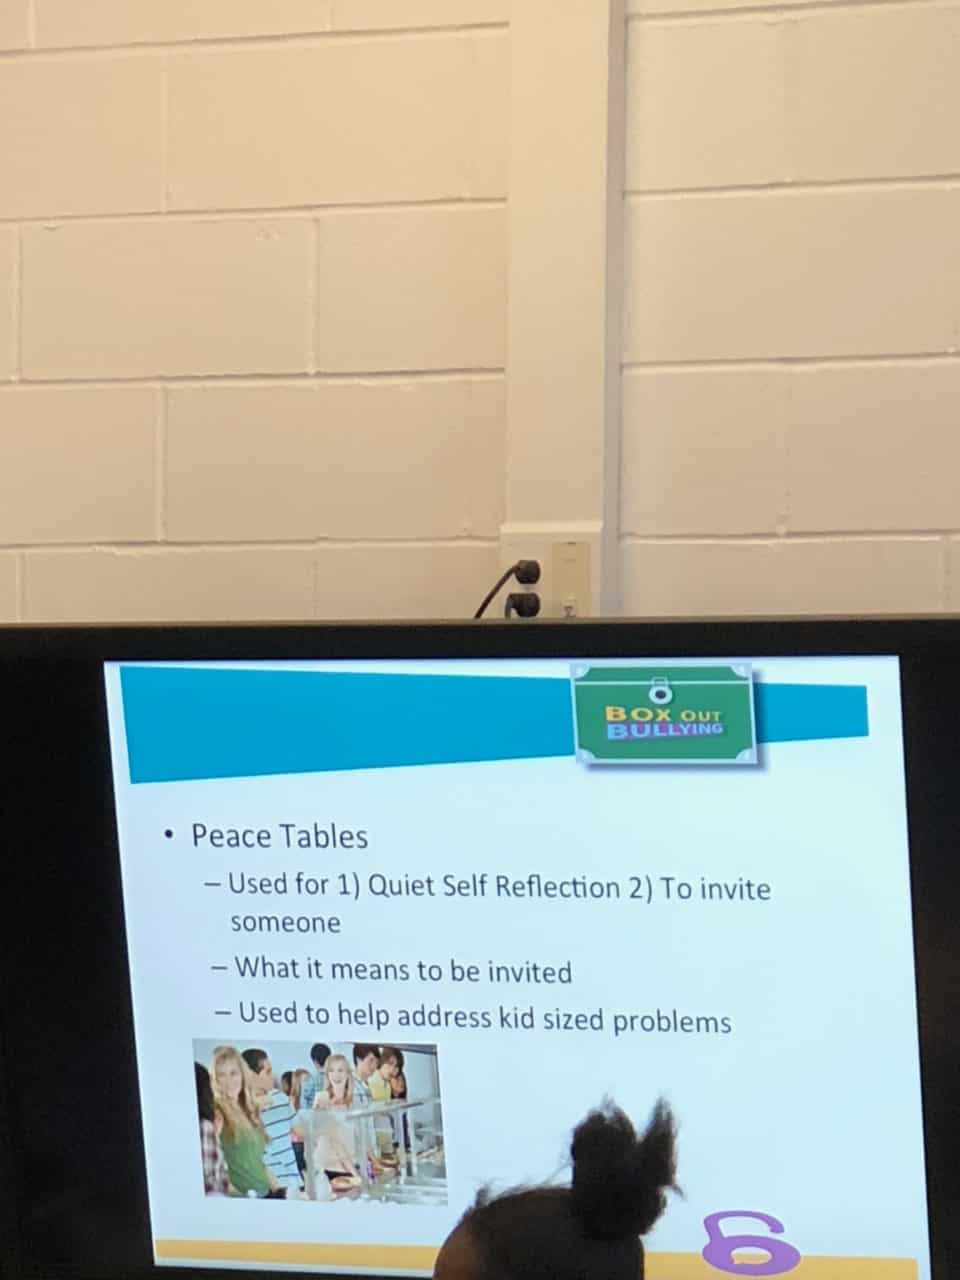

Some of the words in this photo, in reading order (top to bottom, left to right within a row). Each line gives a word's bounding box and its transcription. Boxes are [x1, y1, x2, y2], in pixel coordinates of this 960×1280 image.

[605, 705, 672, 722] BOX
[680, 711, 723, 723] OUT
[606, 722, 724, 741] BULLYING
[193, 824, 270, 848] Peace
[279, 823, 367, 848] Tables
[229, 872, 287, 894] Used
[296, 872, 328, 894] for
[339, 872, 359, 900] 1)
[369, 874, 435, 897] Quiet
[444, 874, 487, 896] Self
[496, 874, 619, 898] Reflection
[630, 875, 652, 904] 2)
[660, 877, 691, 899] To
[702, 878, 770, 900] invite
[232, 916, 340, 933] someone
[235, 956, 300, 978] What
[308, 958, 322, 979] it
[332, 963, 409, 980] means
[418, 961, 442, 981] to
[451, 959, 479, 982] be
[489, 960, 571, 983] invited
[240, 1001, 297, 1023] Used
[306, 1005, 329, 1024] to
[338, 1002, 389, 1030] help
[398, 1004, 491, 1028] address
[500, 1006, 534, 1029] kid
[544, 1008, 603, 1030] sized
[614, 1009, 731, 1036] problems
[701, 1210, 801, 1276] 6
